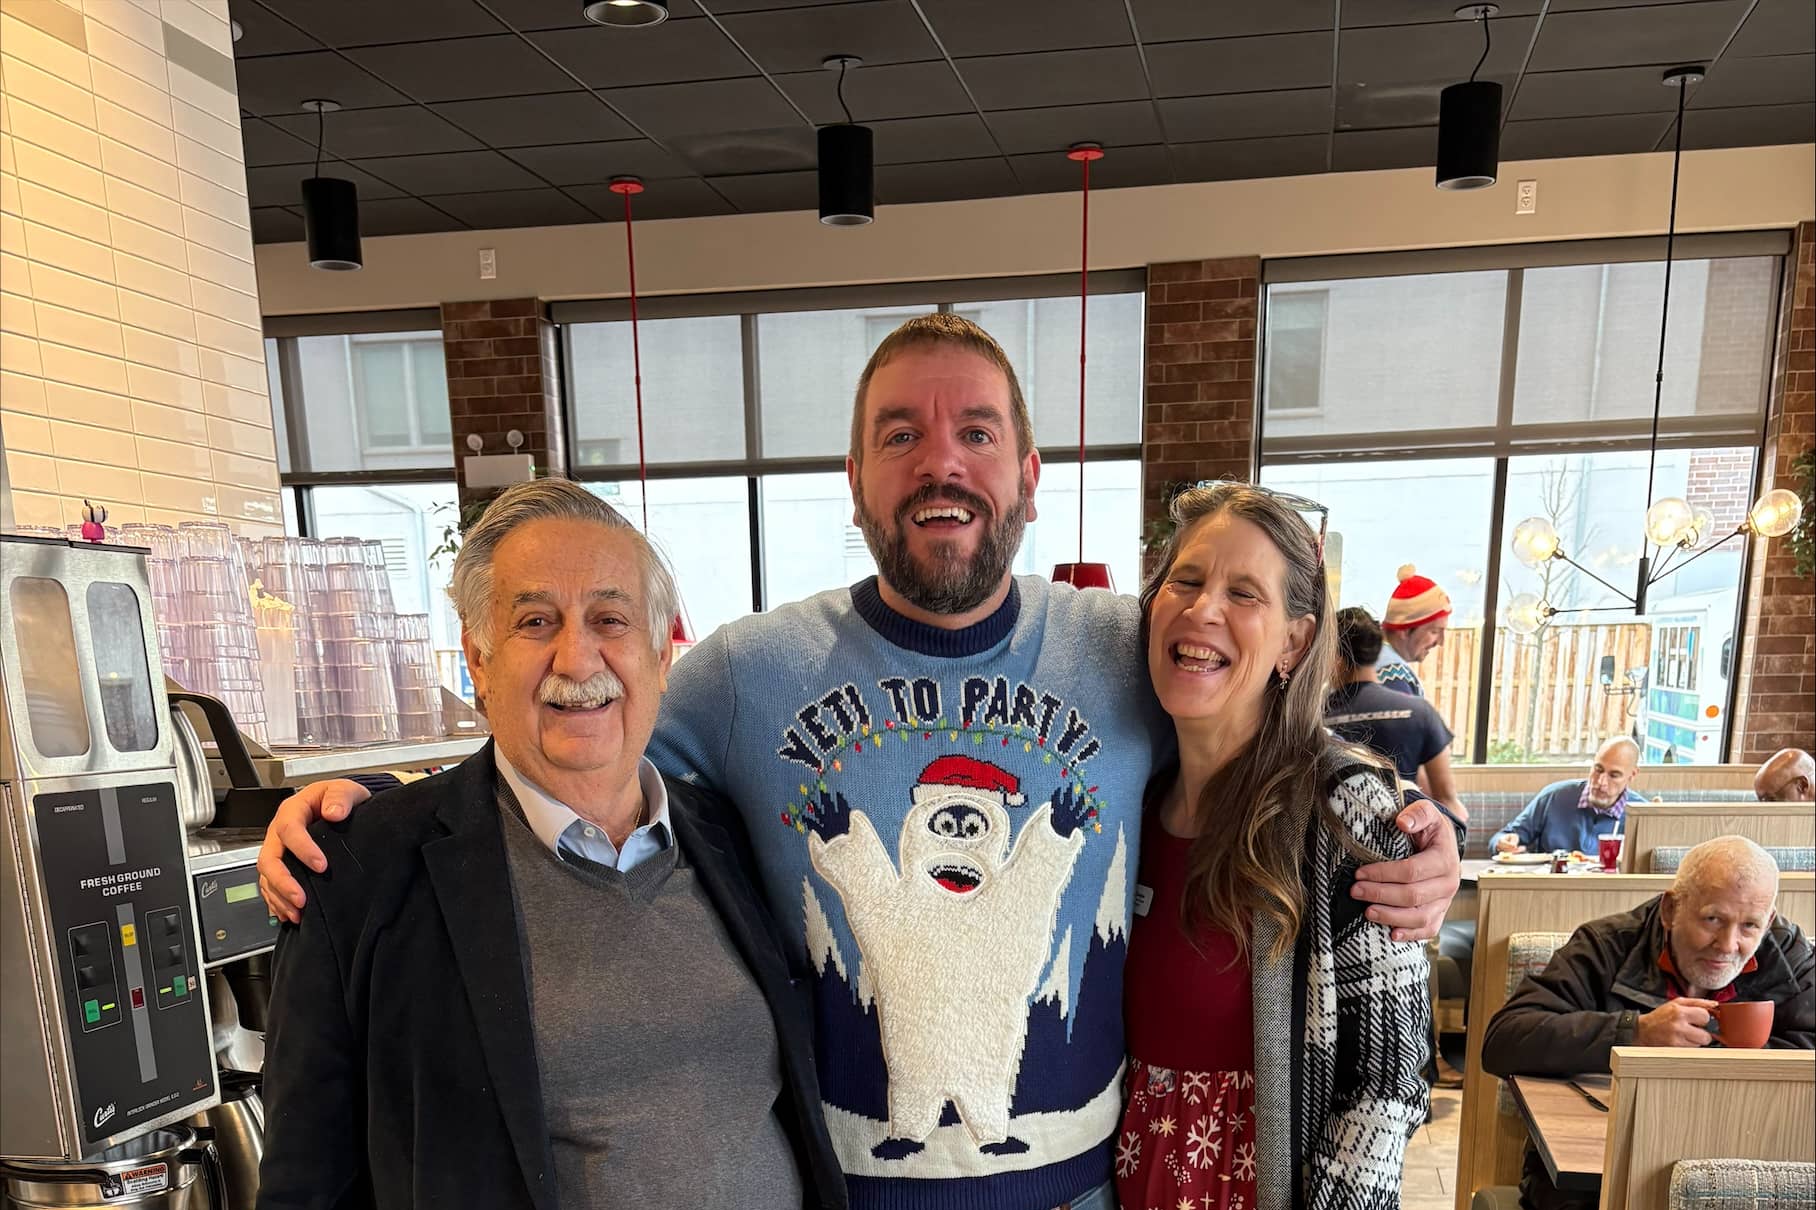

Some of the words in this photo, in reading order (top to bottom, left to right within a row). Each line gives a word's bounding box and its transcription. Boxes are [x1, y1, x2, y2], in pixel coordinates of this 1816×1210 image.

[777, 682, 872, 770] YETI
[877, 675, 943, 725] TO
[960, 674, 1102, 769] PARTY!
[80, 874, 116, 889] FRESH
[117, 867, 161, 883] GROUND
[102, 881, 143, 896] COFFEE
